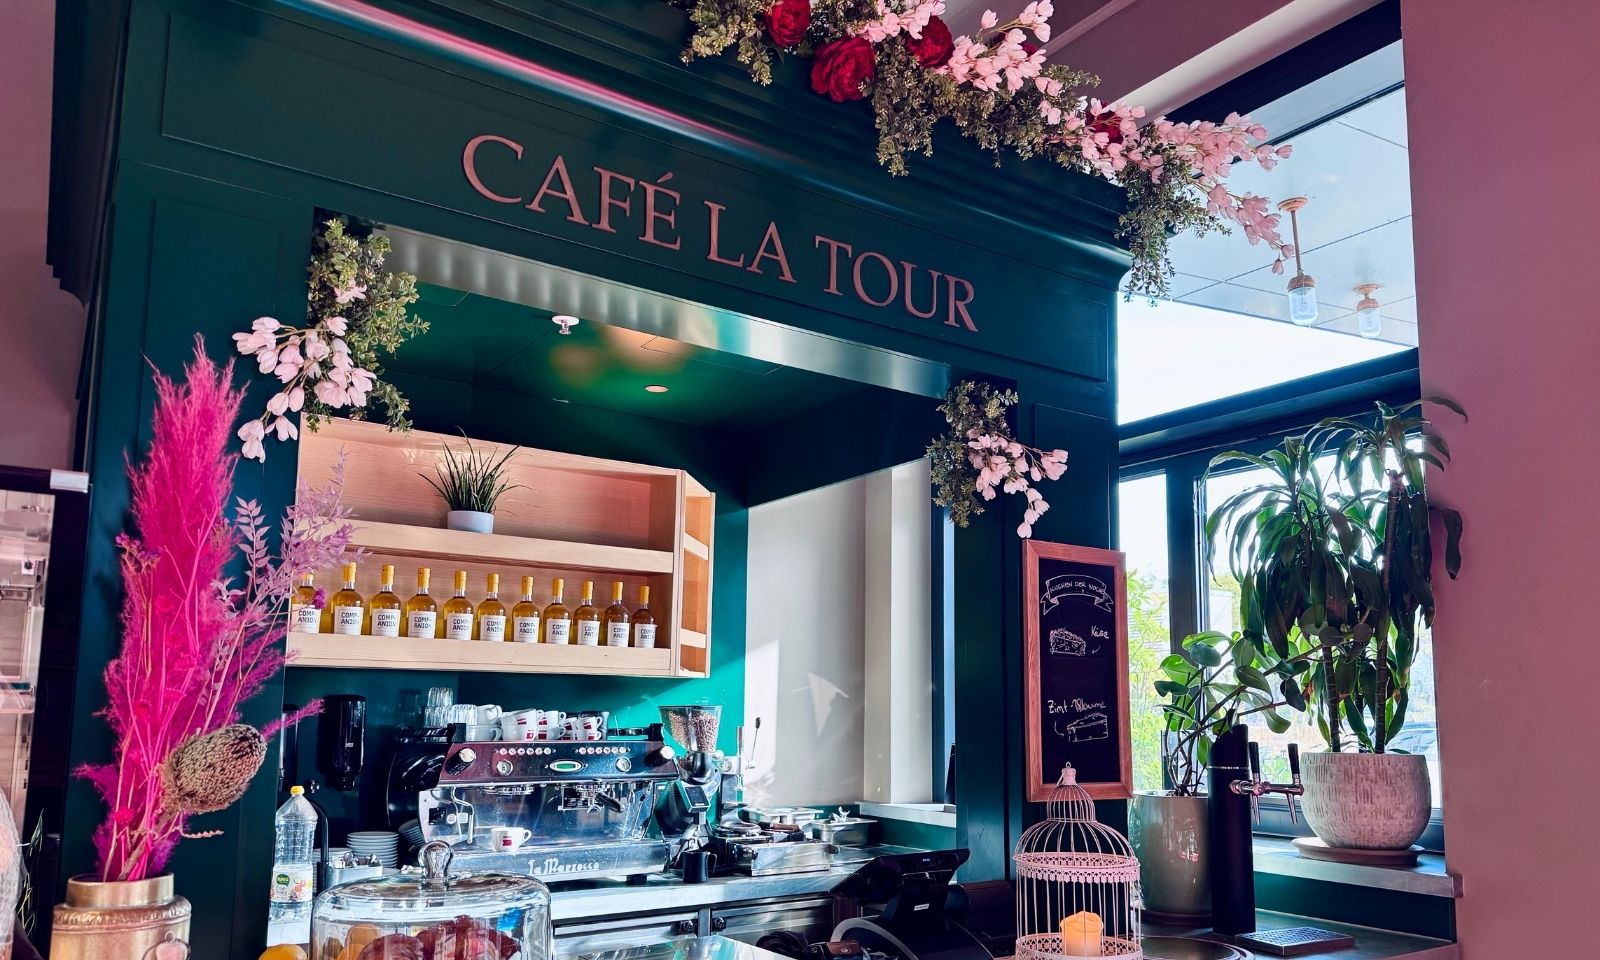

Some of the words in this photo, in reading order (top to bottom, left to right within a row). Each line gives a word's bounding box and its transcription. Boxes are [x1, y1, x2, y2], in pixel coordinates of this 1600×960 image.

[462, 133, 682, 252] CAFÉ
[703, 199, 798, 284] LA
[814, 235, 979, 334] TOUR
